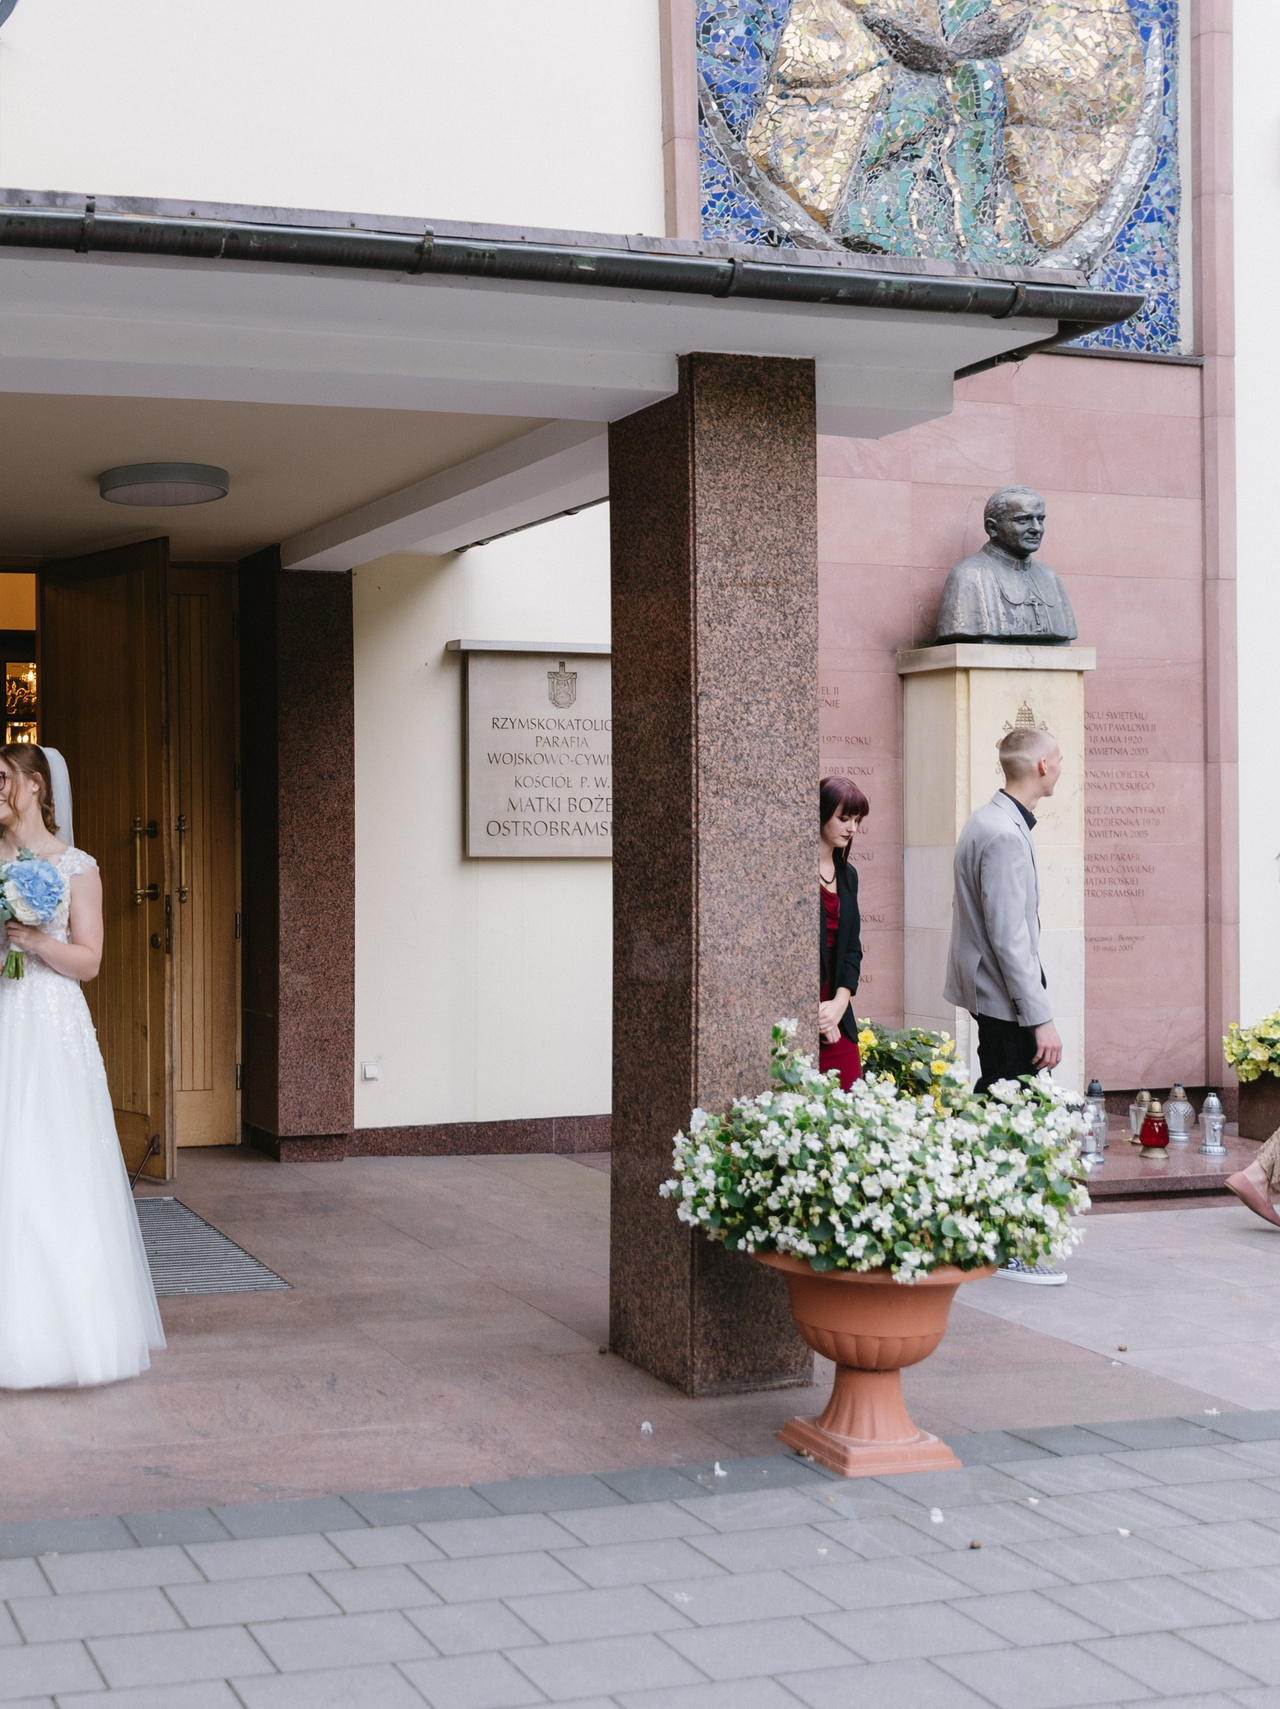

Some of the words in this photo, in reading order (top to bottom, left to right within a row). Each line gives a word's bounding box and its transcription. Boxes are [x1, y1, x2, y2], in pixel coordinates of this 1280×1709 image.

[834, 687, 839, 695] II
[492, 717, 612, 731] RZYMSKOKATOLIC
[1109, 724, 1149, 732] PAWŁOWI
[536, 736, 589, 748] PARAFIA
[845, 736, 872, 745] ROKU
[1089, 747, 1128, 755] KWIETNIA
[825, 767, 844, 775] 1983
[848, 767, 874, 775] ROKU
[514, 772, 572, 788] KOŚCIÓŁ
[580, 777, 589, 788] P.
[594, 777, 610, 788] W.
[1110, 782, 1154, 790] POLSKIEGO
[507, 797, 561, 812] MATKI
[568, 794, 612, 813] BOŻE
[1104, 806, 1114, 814] ZA
[1117, 806, 1165, 814] PONTYFIKAT
[1089, 830, 1128, 838] KWIETNIA
[1130, 830, 1148, 838] 2005
[1111, 853, 1140, 861] PARAFII
